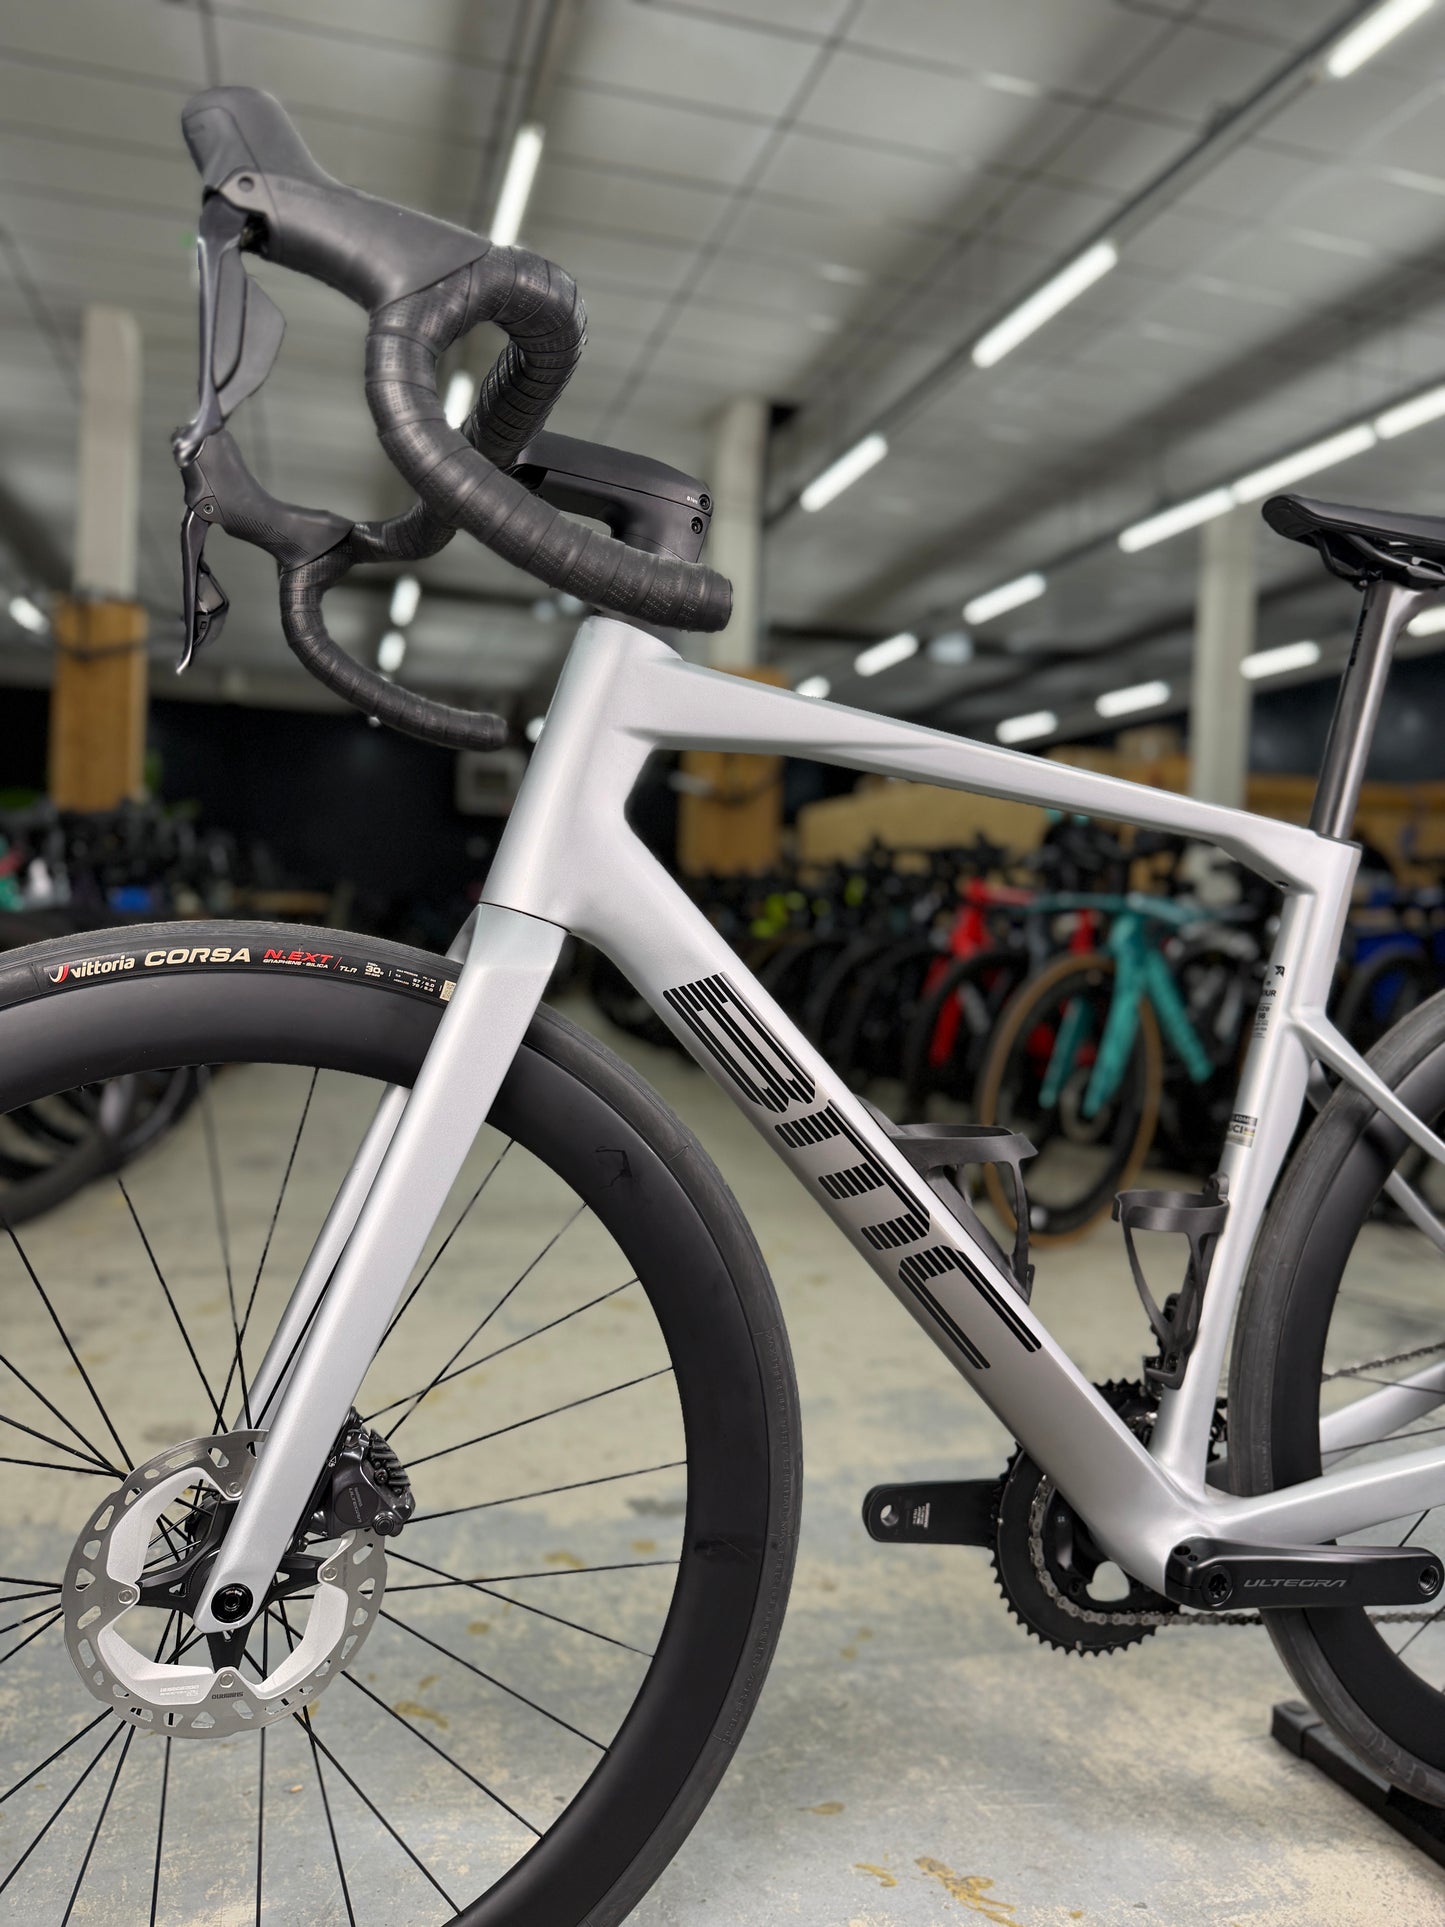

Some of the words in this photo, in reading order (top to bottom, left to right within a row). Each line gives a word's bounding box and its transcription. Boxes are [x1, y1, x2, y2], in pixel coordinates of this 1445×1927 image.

[71, 955, 135, 978] vittoria
[144, 947, 251, 967] CORSA
[263, 949, 334, 964] N.EXT
[663, 972, 1042, 1369] BMC
[1244, 1579, 1347, 1588] ULTEGRA
